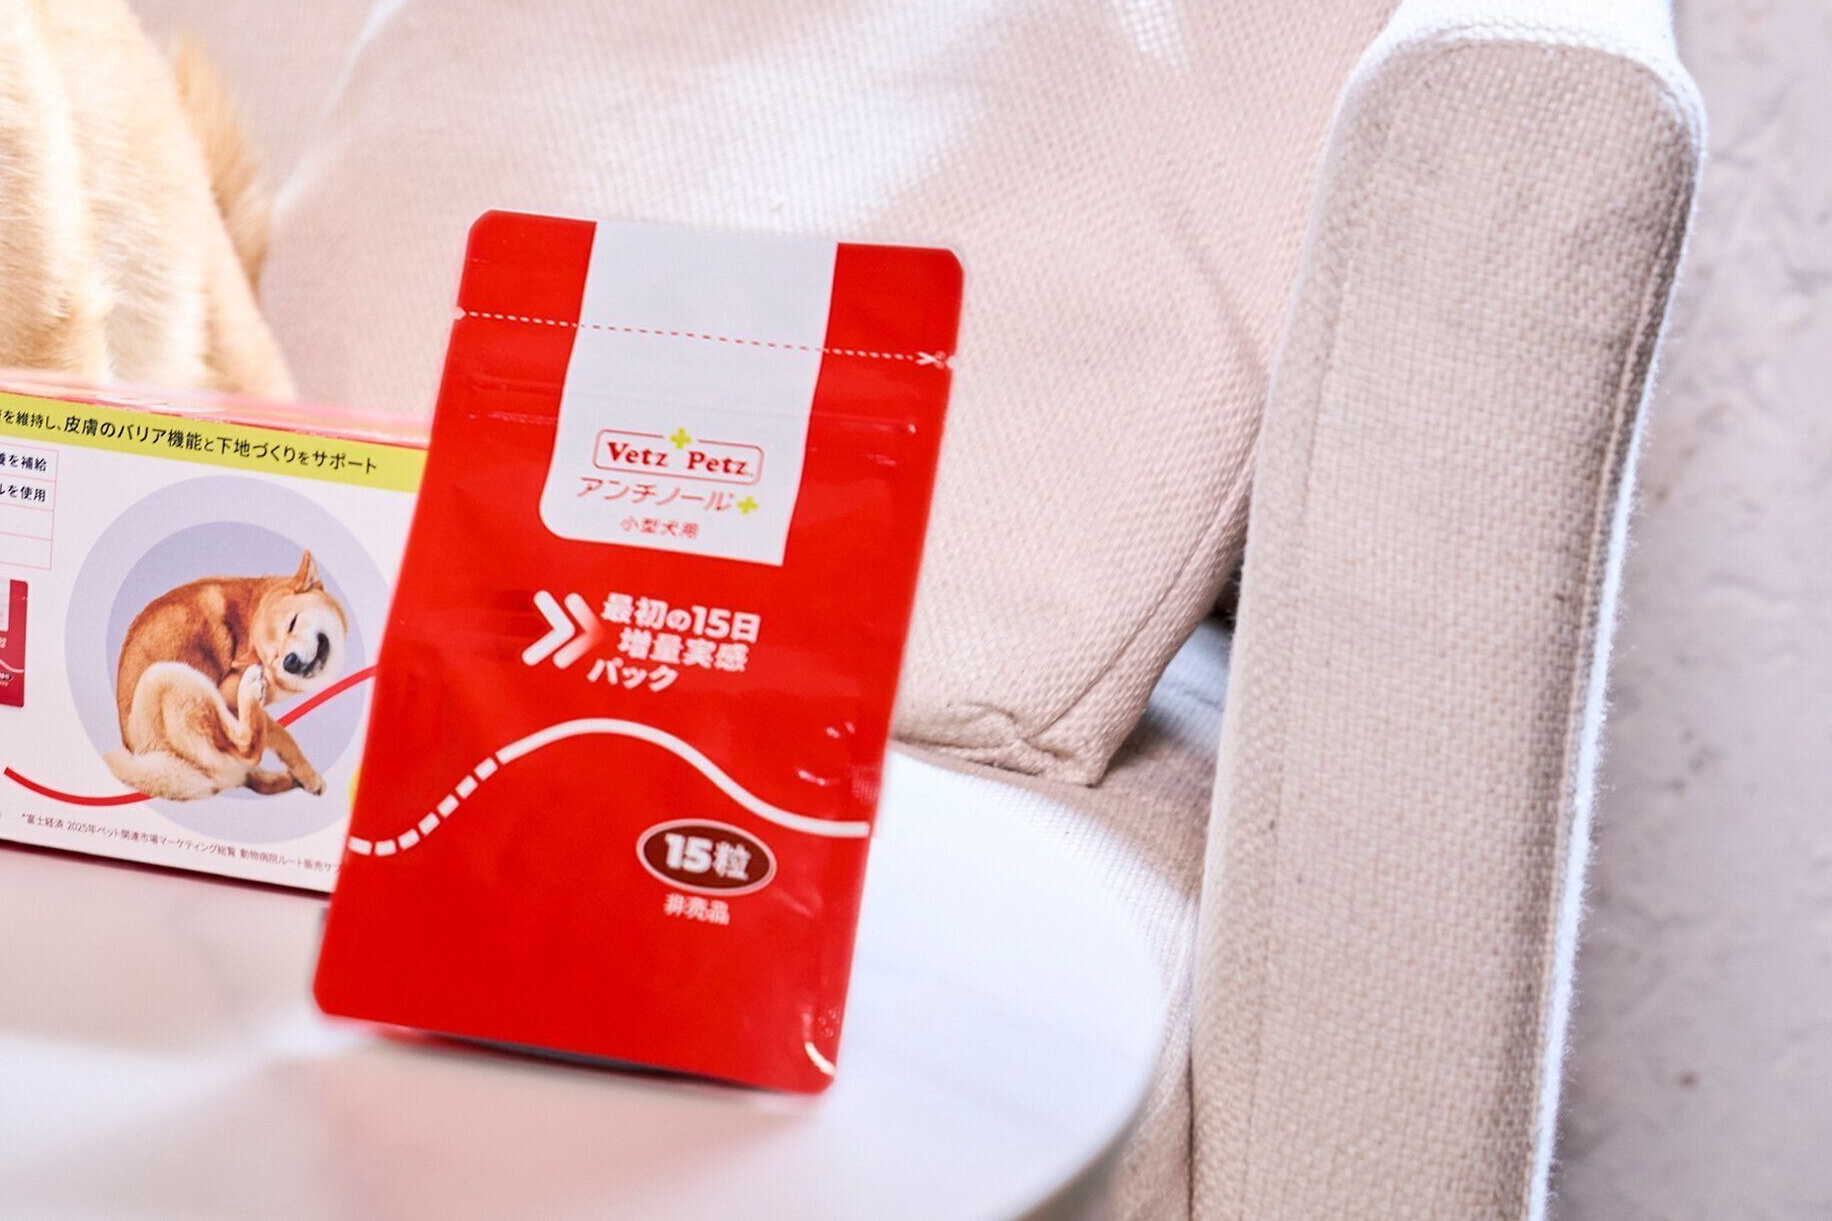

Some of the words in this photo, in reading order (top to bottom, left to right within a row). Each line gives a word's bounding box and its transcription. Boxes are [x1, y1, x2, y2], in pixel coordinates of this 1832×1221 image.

[607, 441, 668, 467] Vetz
[687, 451, 748, 476] Petz
[601, 592, 761, 644] 最初の15日
[618, 627, 749, 672] 増量実感
[586, 657, 679, 692] パック
[665, 832, 751, 882] 15粒
